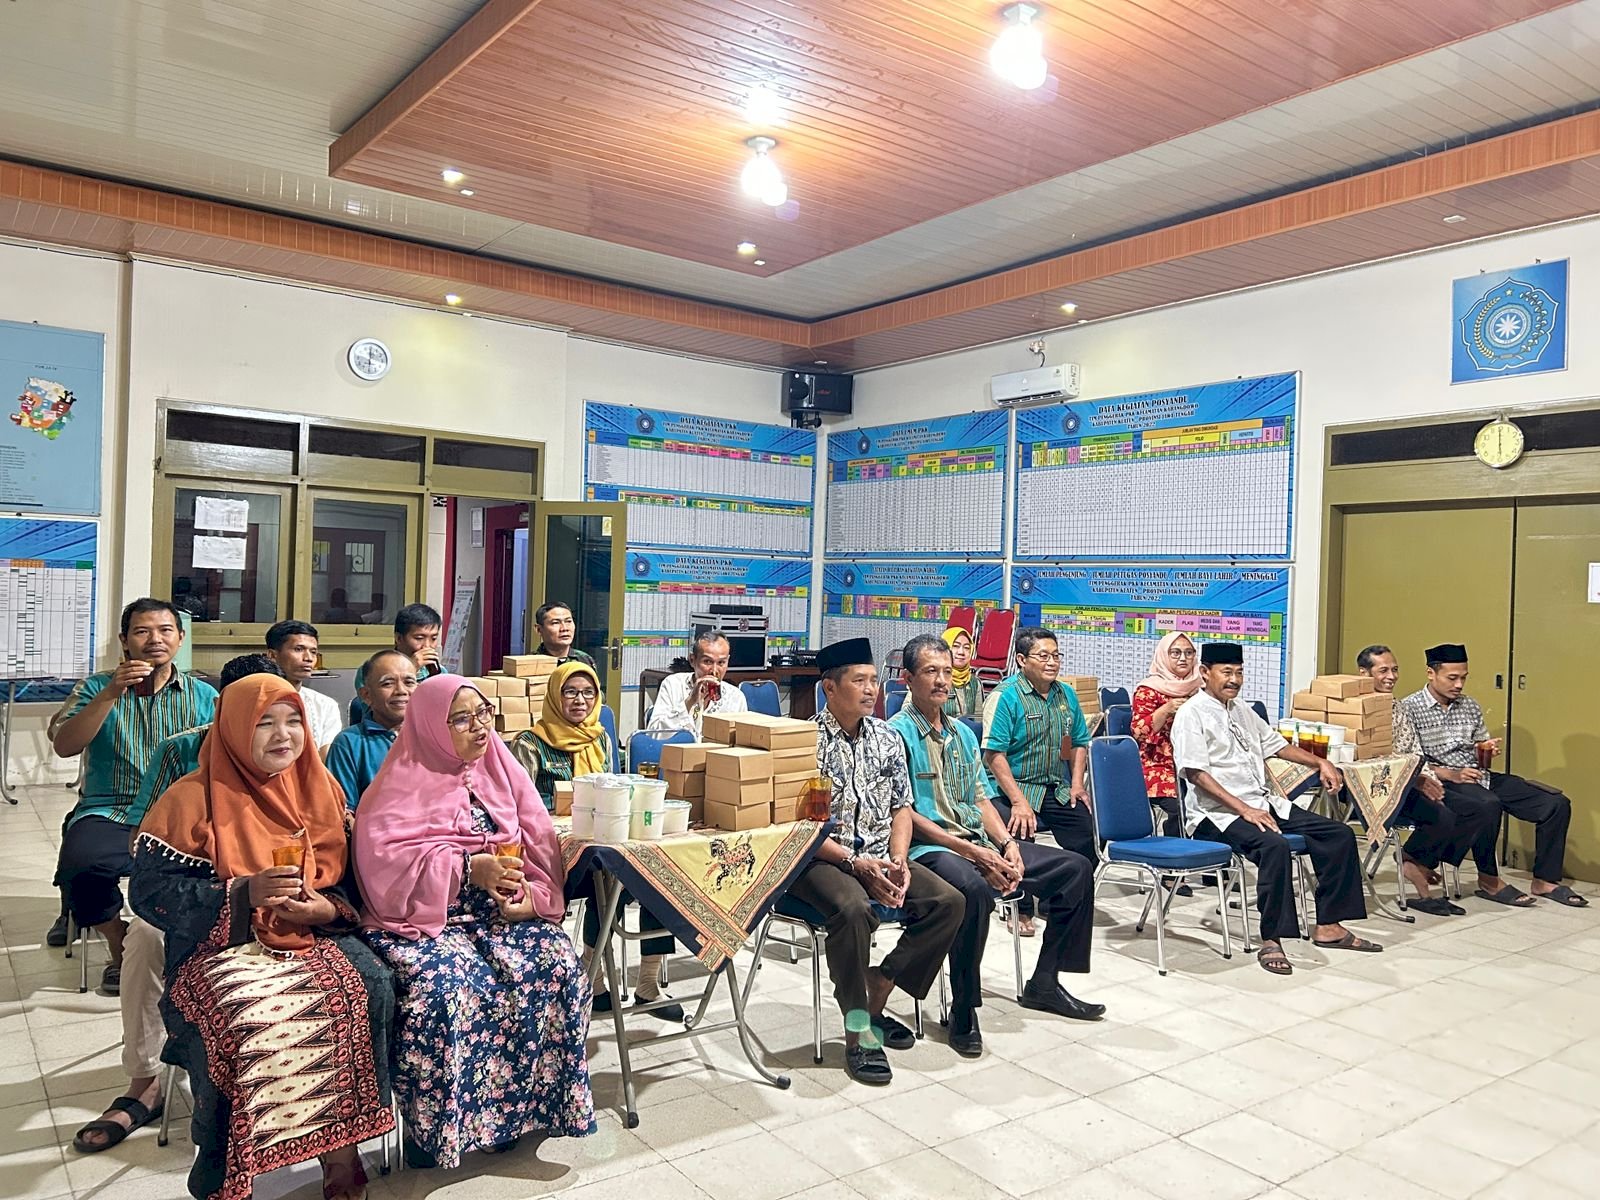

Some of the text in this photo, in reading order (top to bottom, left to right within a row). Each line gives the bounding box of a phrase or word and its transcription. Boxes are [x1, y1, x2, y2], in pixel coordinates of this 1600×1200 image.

[1098, 396, 1187, 414] DATA KEGIATAN POSYANDU
[1241, 572, 1277, 580] MENINGGAL
